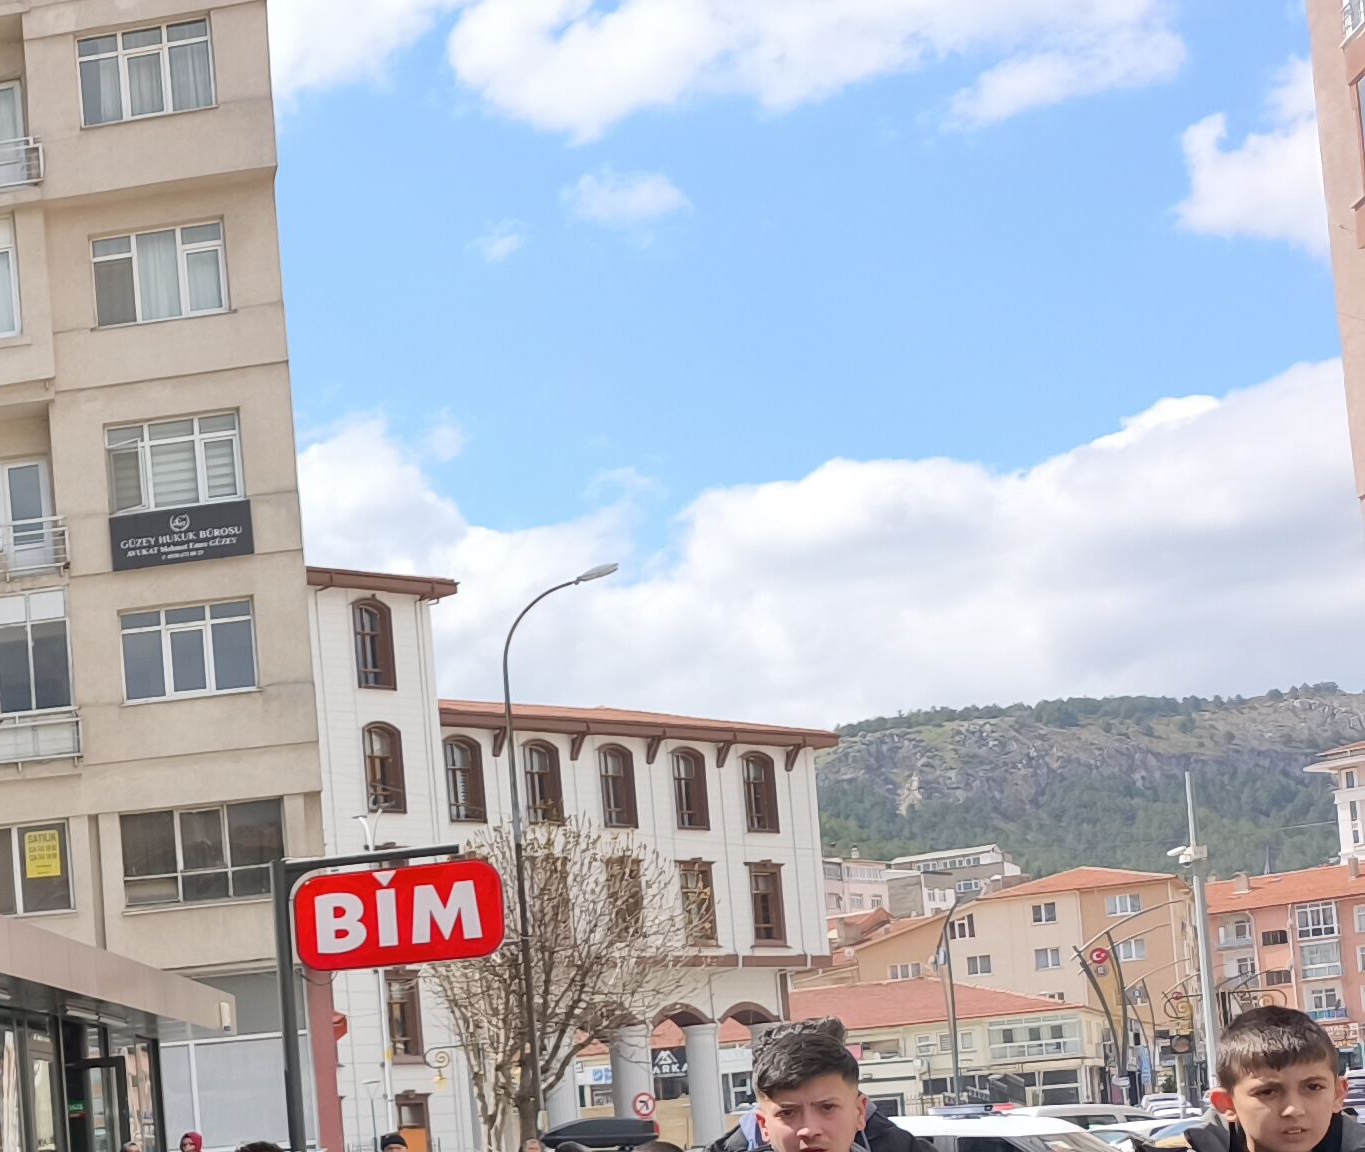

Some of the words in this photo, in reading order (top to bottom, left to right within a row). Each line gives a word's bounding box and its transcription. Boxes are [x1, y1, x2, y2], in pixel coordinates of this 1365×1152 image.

[158, 531, 198, 544] HUKUK
[199, 526, 243, 539] BÜROSU
[314, 870, 483, 956] BİM
